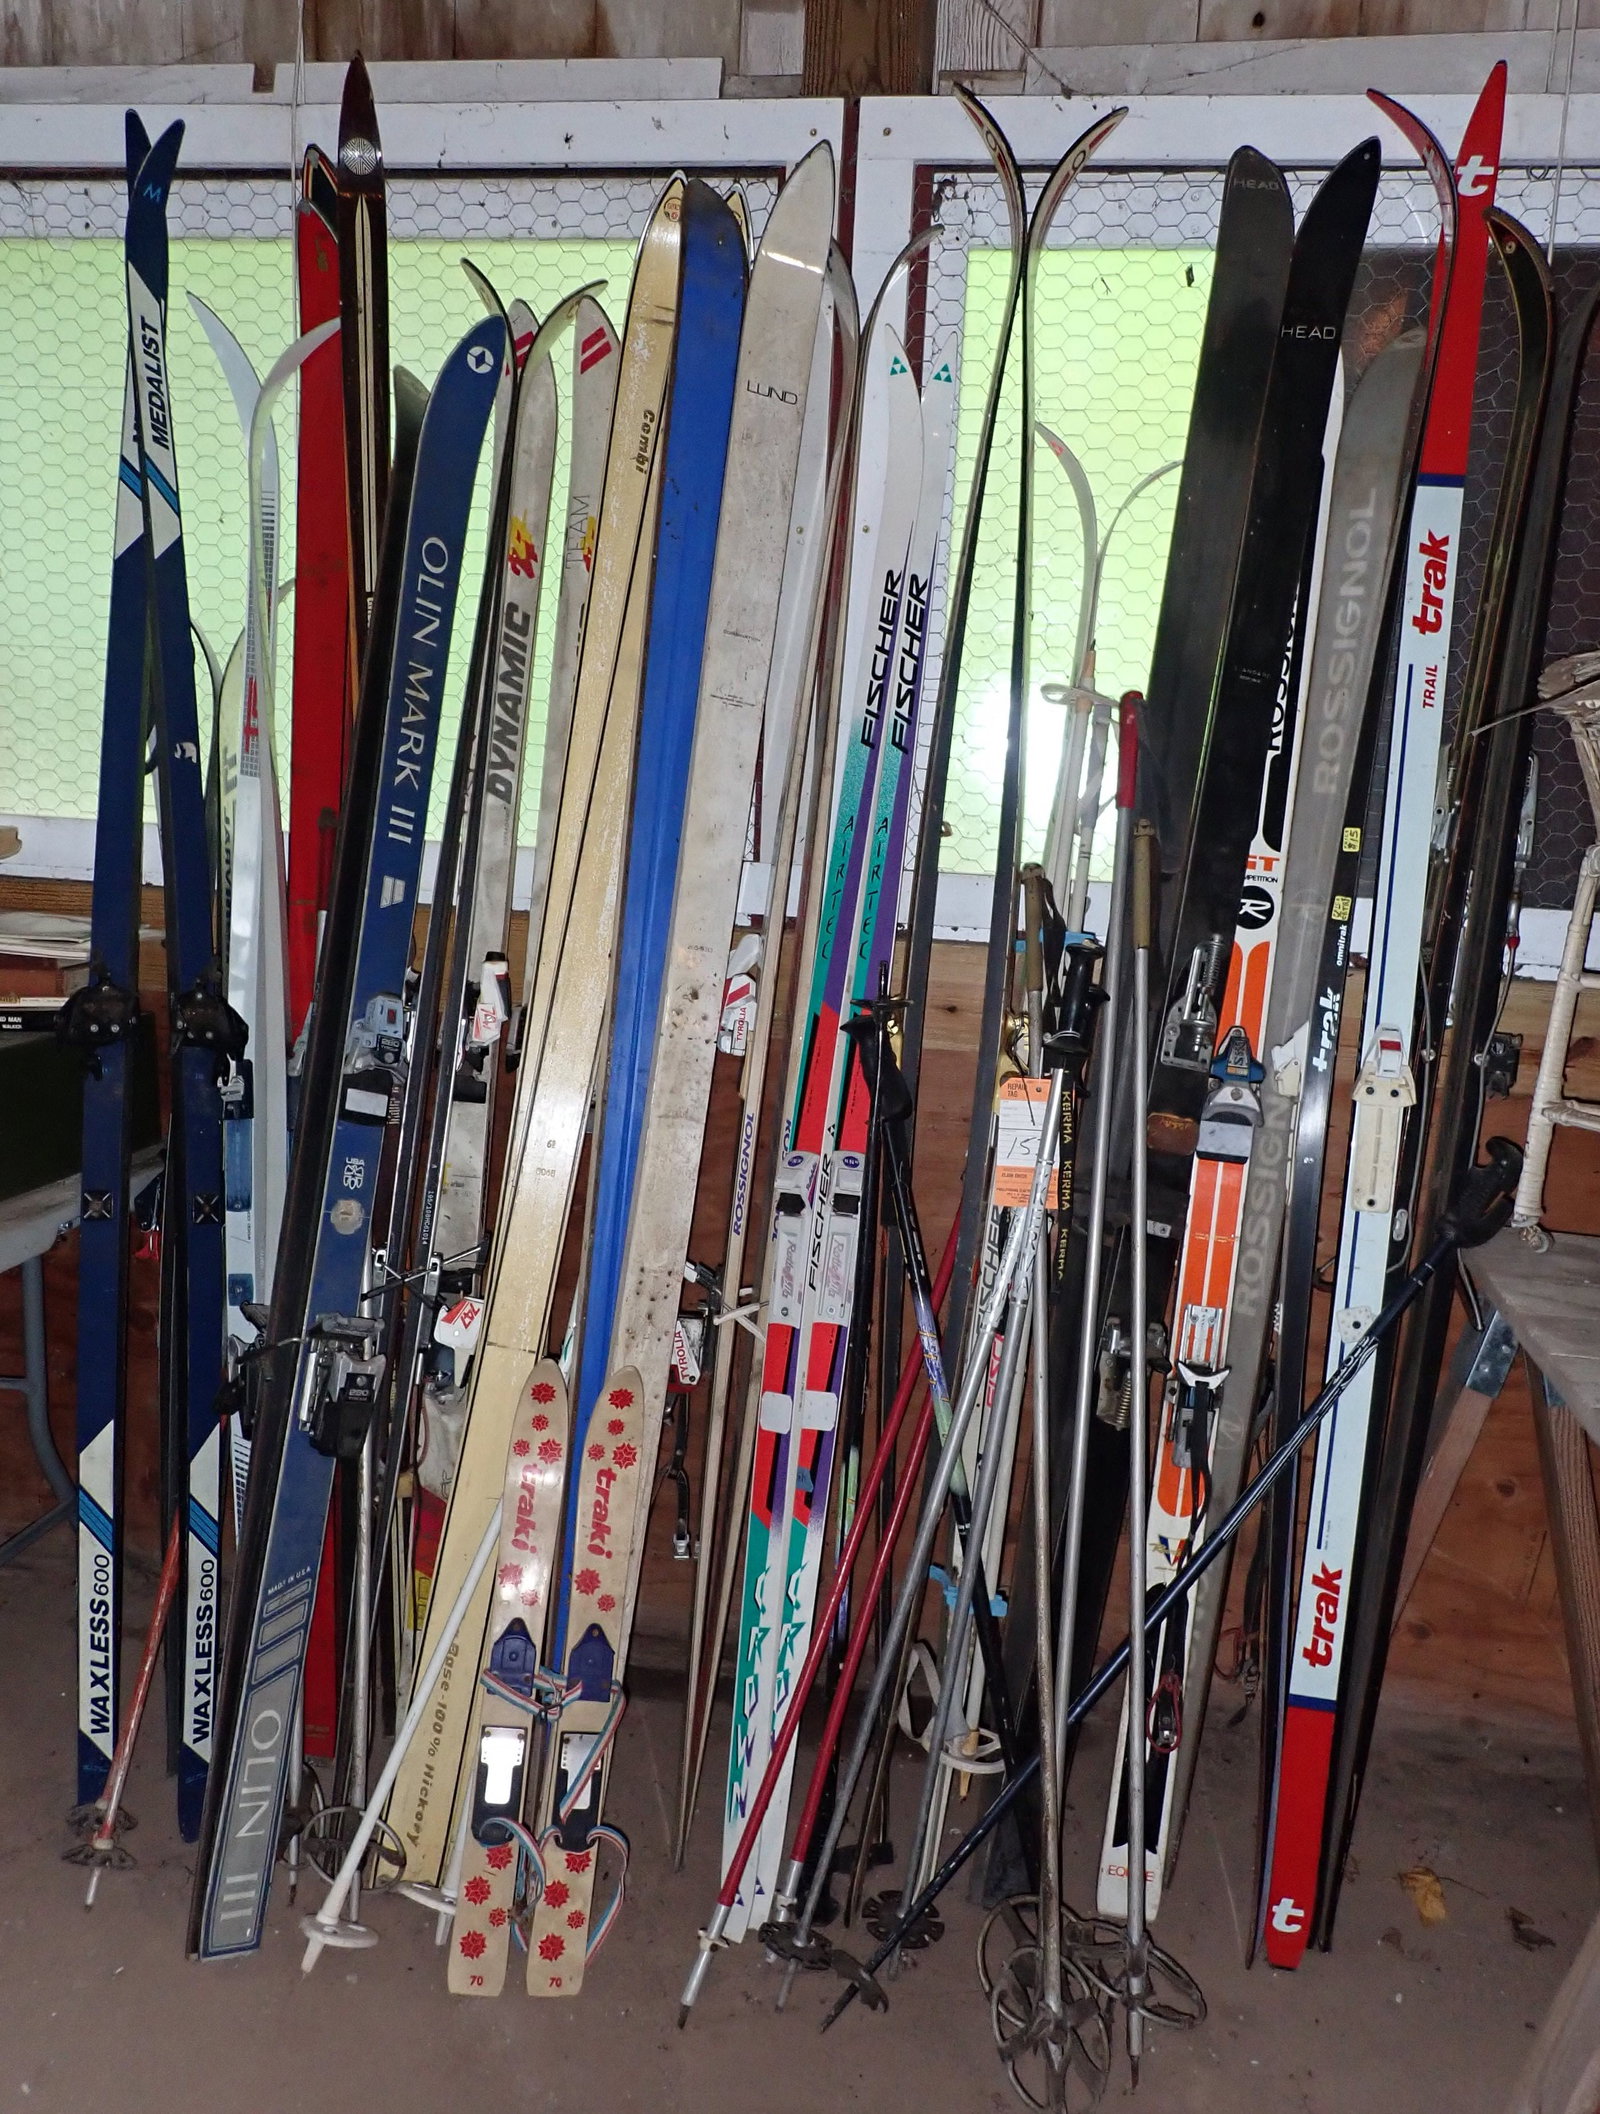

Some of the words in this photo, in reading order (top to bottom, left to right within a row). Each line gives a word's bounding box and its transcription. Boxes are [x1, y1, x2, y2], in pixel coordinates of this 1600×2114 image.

[1233, 178, 1279, 191] HEAD
[1457, 155, 1494, 197] t
[1281, 324, 1336, 341] HEAD
[140, 315, 170, 451] MEDALIST
[746, 379, 798, 406] LUND
[566, 494, 590, 570] TEAM
[411, 536, 449, 648] OLIN
[1412, 528, 1450, 636] trak
[860, 569, 902, 751] FISCHER
[890, 573, 929, 756] FISCHER
[1312, 486, 1377, 795] ROSSIGNOL
[484, 600, 531, 806] DYNAMIC
[1422, 663, 1439, 710] TRAIL
[393, 660, 435, 791] MARK
[387, 803, 416, 845] III
[1336, 923, 1348, 968] omnitrak
[736, 1007, 747, 1041] TYROLIA
[1007, 1090, 1018, 1098] TAG
[1061, 1090, 1073, 1144] KERMA
[732, 1112, 755, 1237] ROSSIGNOL
[1061, 1160, 1073, 1211] KERMA
[808, 1152, 833, 1293] FISCHER
[460, 1302, 481, 1330] 747
[674, 1329, 689, 1381] TYROLIA
[93, 1554, 110, 1596] 600
[200, 1558, 215, 1602] 600
[1302, 1561, 1343, 1669] trak
[89, 1598, 110, 1735] WAXLESS
[192, 1602, 214, 1745] WAXLESS
[234, 1708, 282, 1839] OLIN
[220, 1871, 259, 1922] III
[1271, 1897, 1305, 1933] t
[469, 1975, 484, 1987] 70
[548, 1976, 562, 1988] 70
